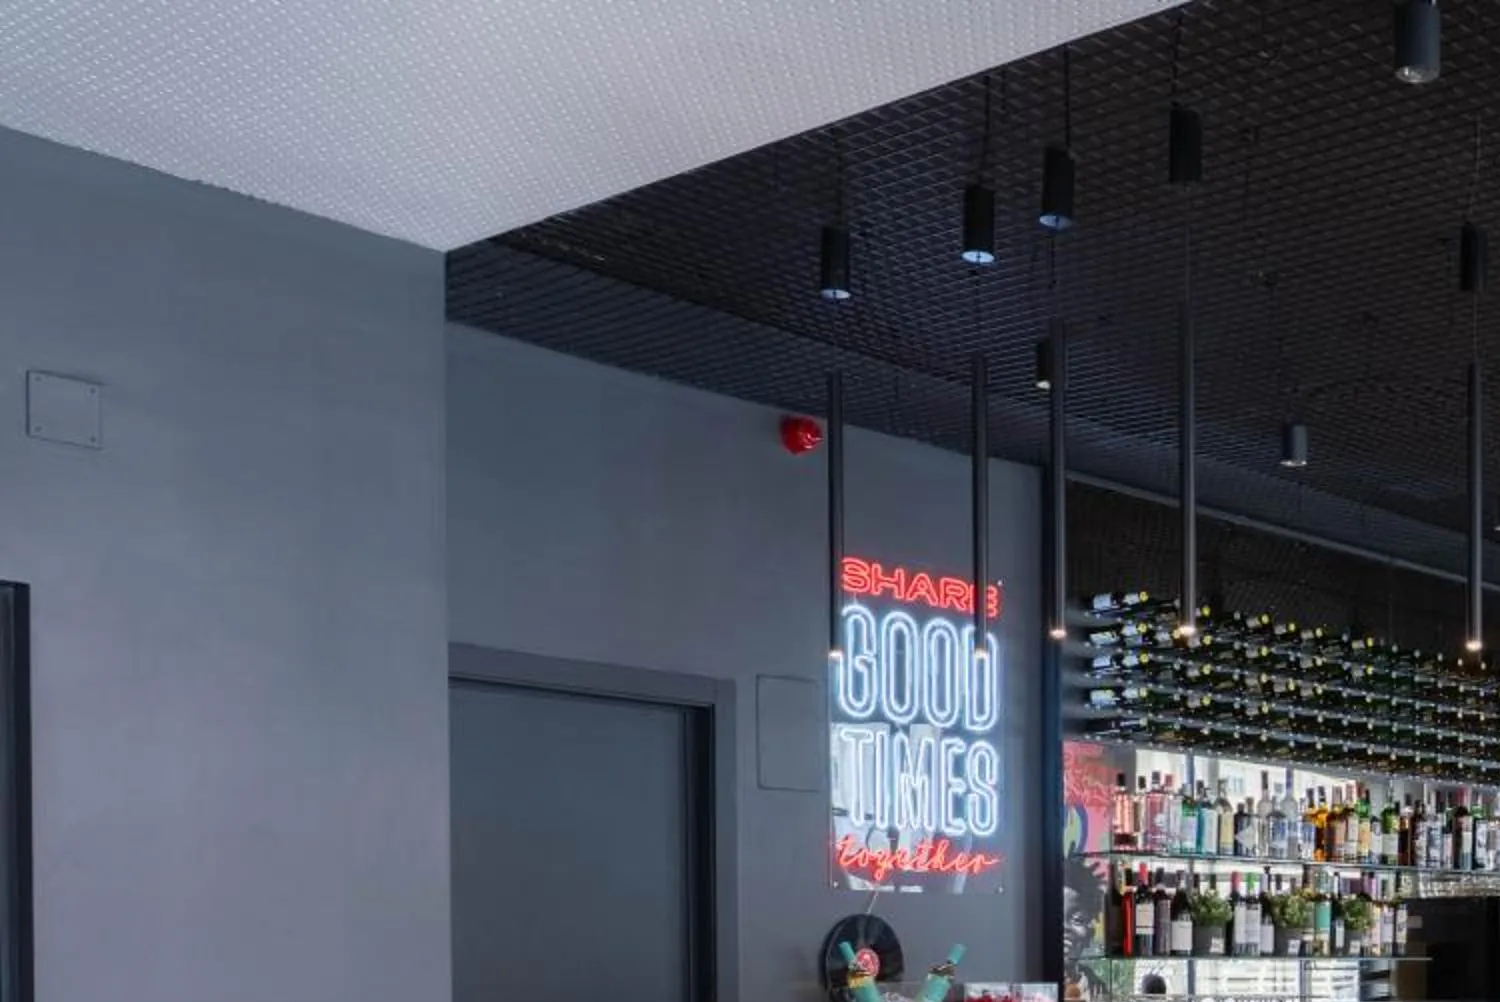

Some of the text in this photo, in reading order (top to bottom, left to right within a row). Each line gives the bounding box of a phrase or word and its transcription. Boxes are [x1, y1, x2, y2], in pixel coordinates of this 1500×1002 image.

[839, 603, 999, 732] GOOD
[839, 728, 999, 837] TIMES
[837, 836, 1000, 880] together
